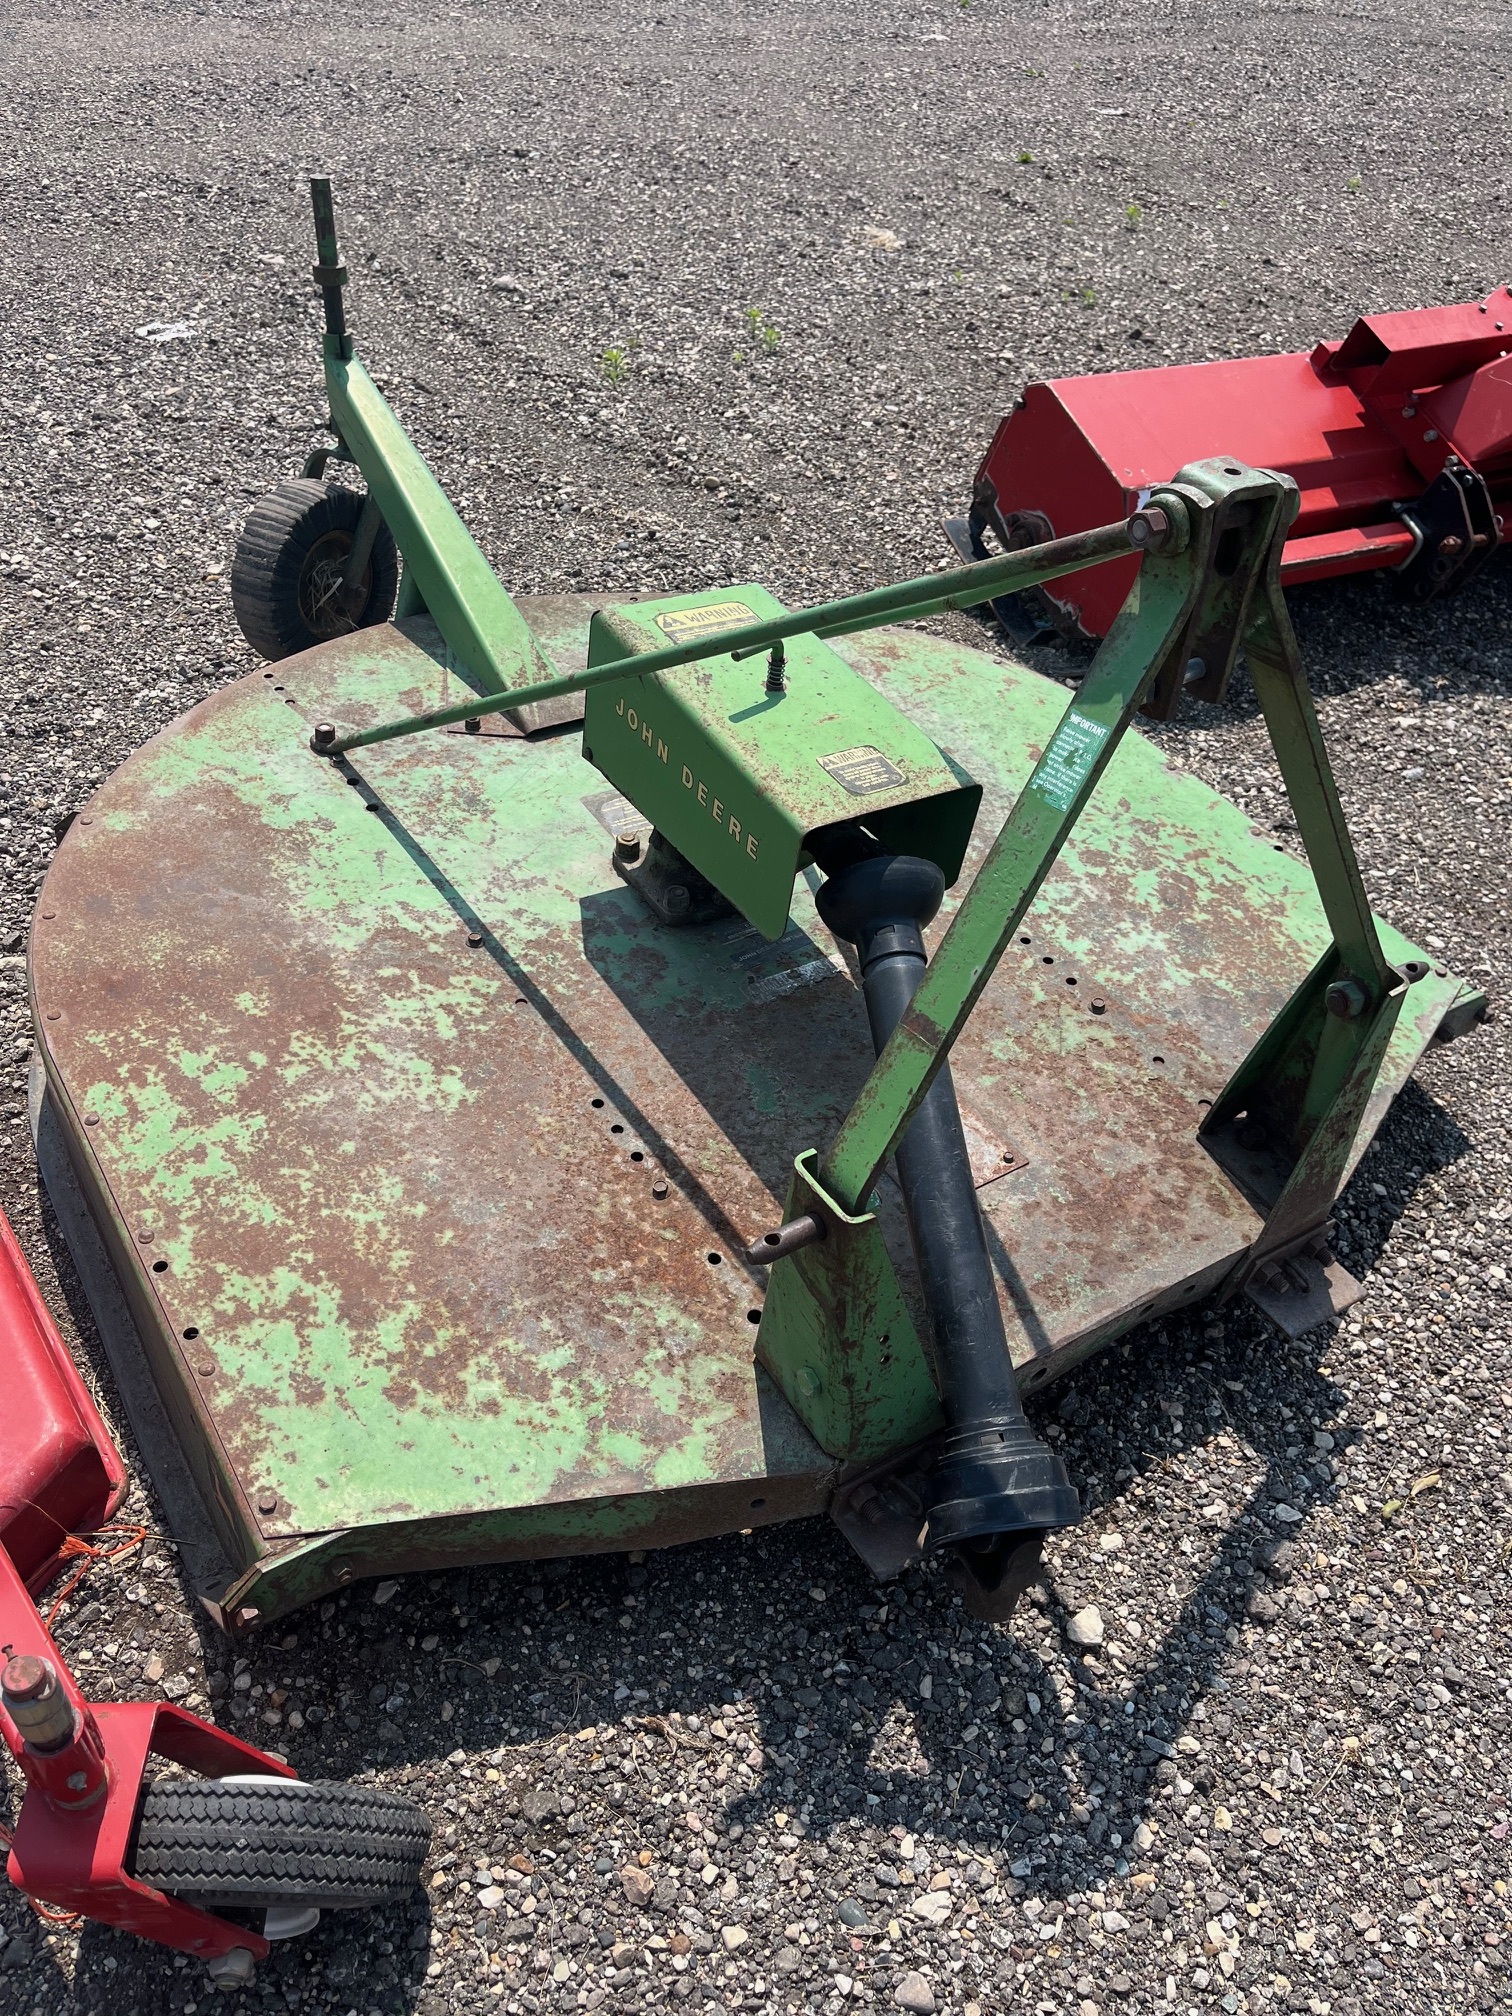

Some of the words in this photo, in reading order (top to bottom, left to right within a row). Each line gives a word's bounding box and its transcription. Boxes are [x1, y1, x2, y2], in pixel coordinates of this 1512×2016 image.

[684, 605, 750, 623] WARNING
[1069, 714, 1107, 736] IMPORTANT
[616, 698, 669, 765] JOHN
[681, 764, 760, 861] DEERE
